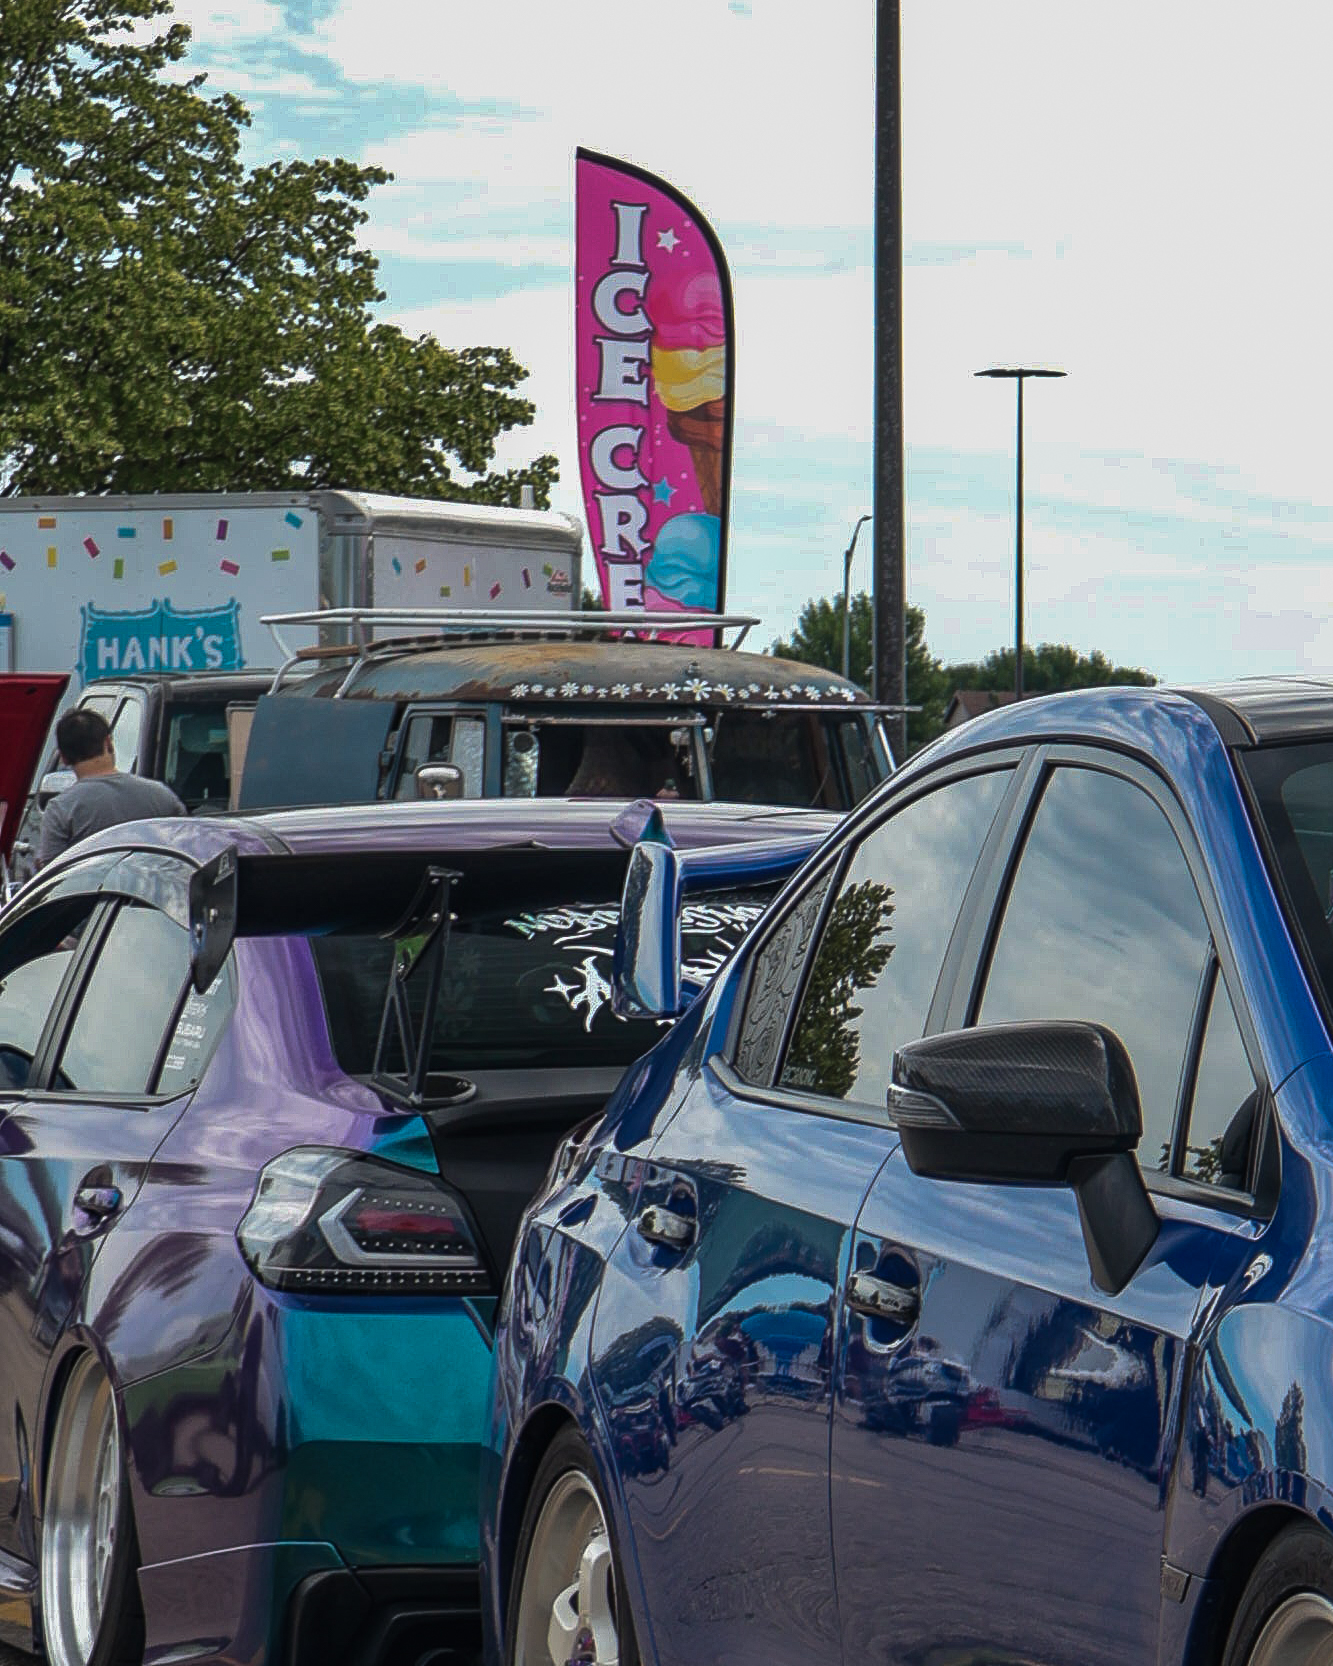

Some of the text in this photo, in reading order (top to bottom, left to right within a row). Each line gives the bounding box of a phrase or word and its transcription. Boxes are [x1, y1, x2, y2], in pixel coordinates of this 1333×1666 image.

[591, 200, 651, 637] ICE CRE
[97, 626, 223, 670] HANK'S
